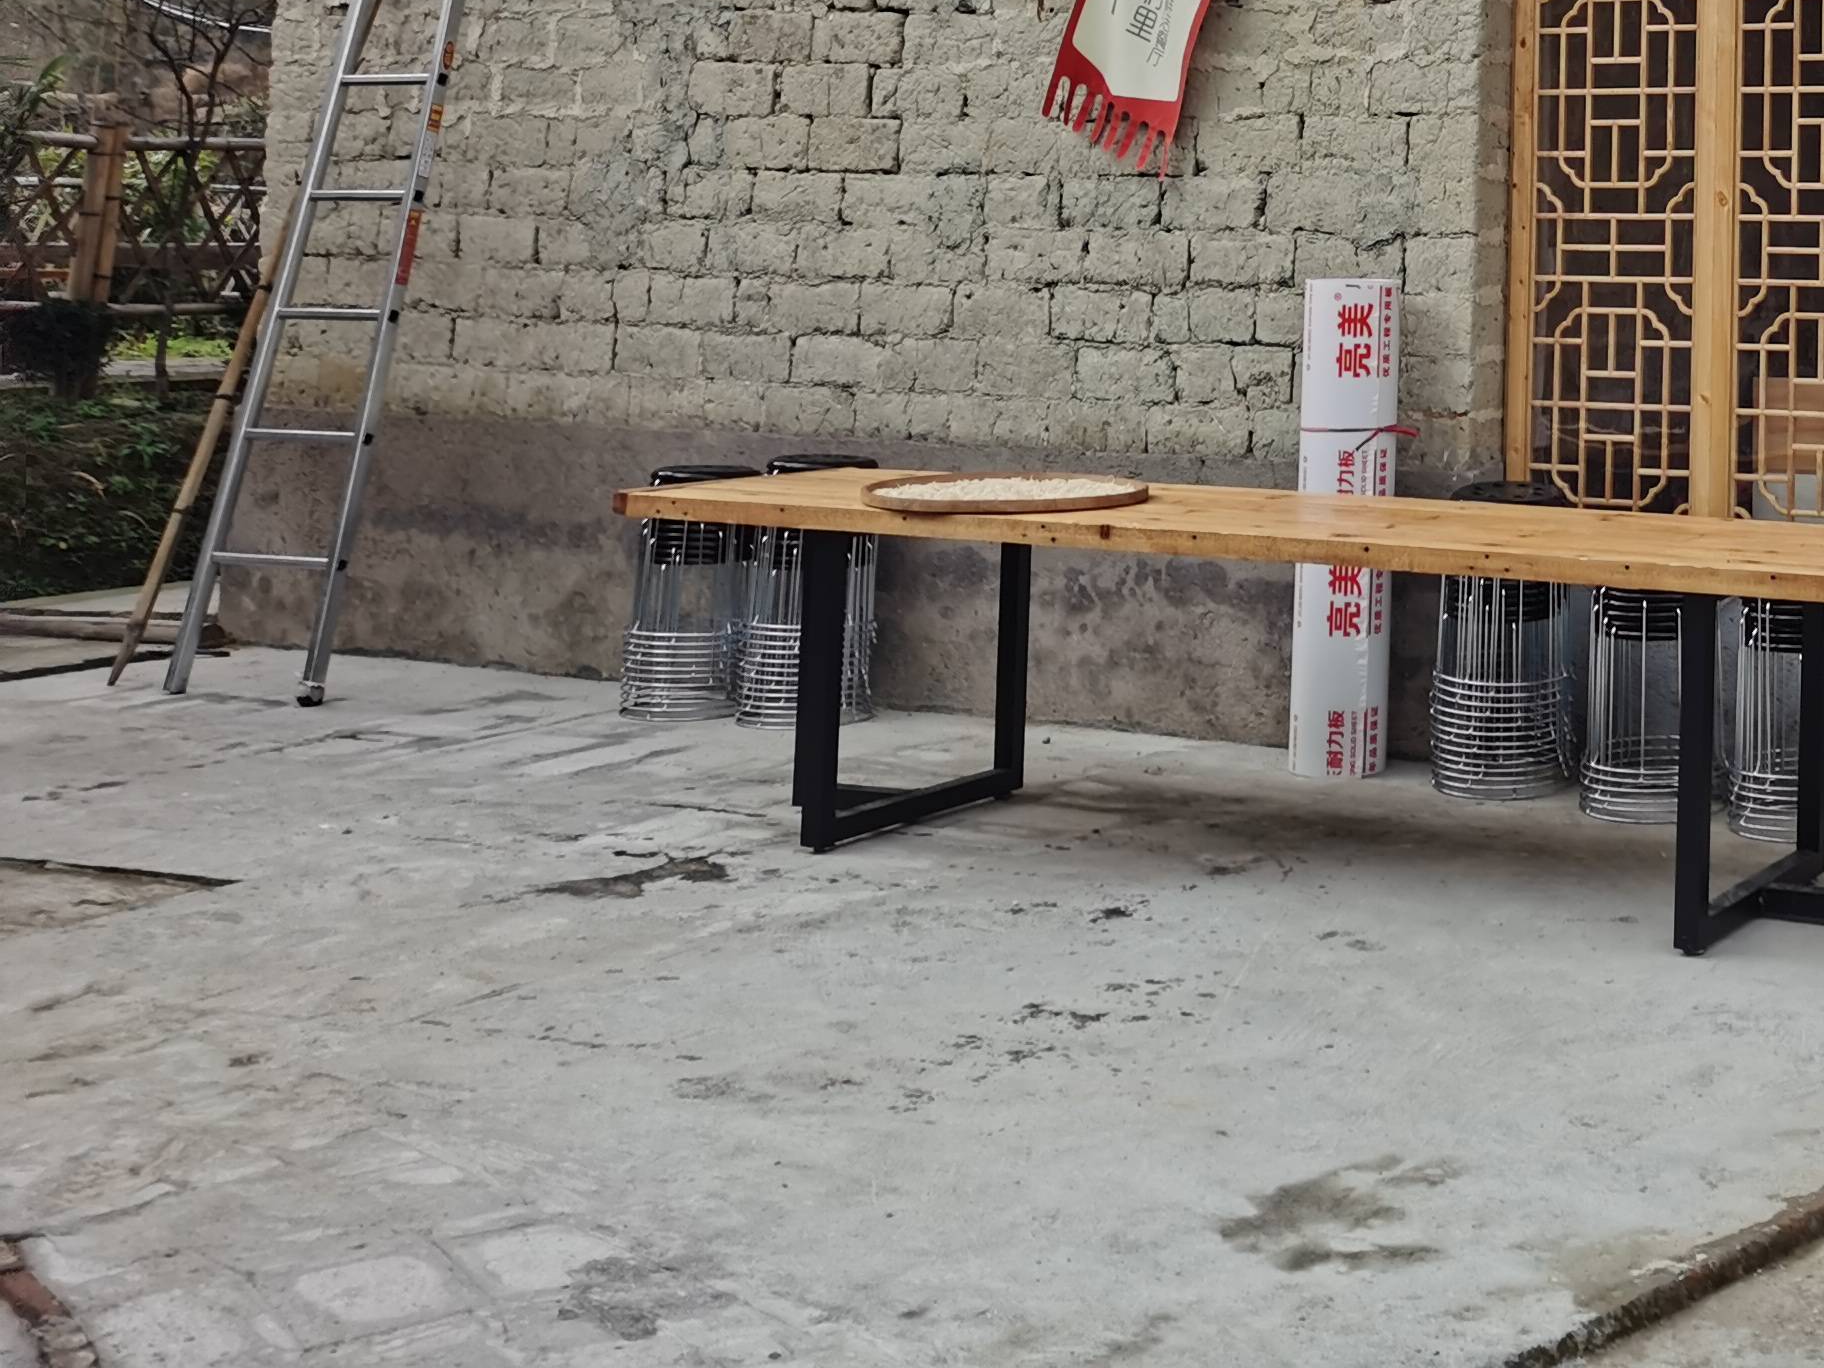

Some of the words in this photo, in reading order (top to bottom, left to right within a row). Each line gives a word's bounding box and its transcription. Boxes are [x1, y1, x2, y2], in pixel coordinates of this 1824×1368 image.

[1336, 302, 1374, 378] 亮美
[1336, 449, 1355, 495] 力板
[1326, 564, 1363, 638] 亮美
